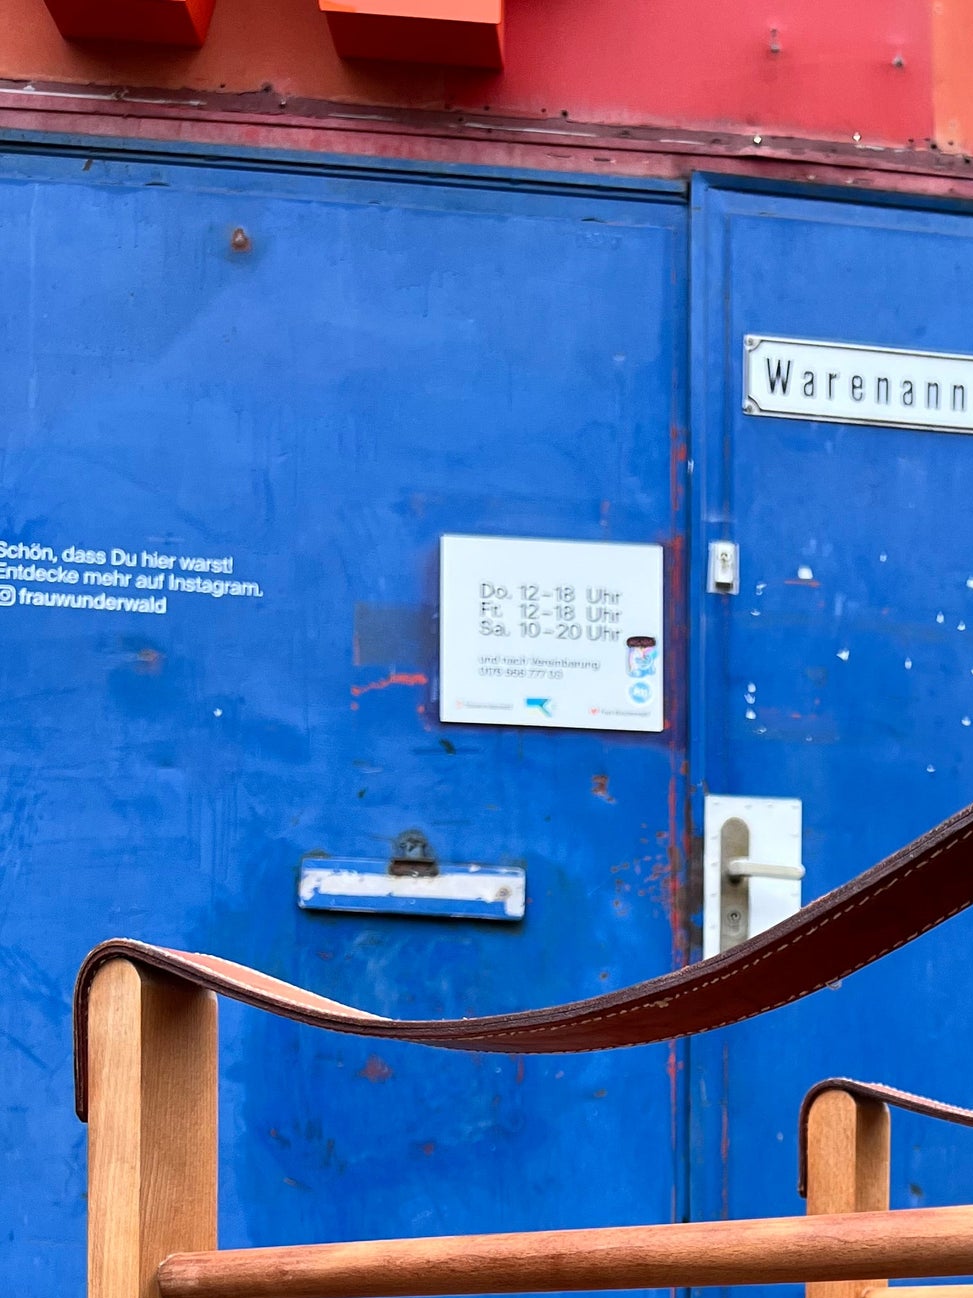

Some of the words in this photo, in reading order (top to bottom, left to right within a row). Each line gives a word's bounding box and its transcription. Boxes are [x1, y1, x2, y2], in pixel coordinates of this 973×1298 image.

[0, 540, 58, 564] Schön,
[61, 545, 107, 565] dass
[110, 548, 137, 567] Du
[141, 550, 177, 569] hier
[179, 556, 234, 574] warst!
[0, 561, 80, 584] Entdecke
[83, 569, 132, 588] mehr
[135, 572, 165, 590] auf
[168, 573, 264, 598] Instagram.
[19, 587, 167, 614] frauwunderwald
[480, 583, 512, 599] Do.
[586, 587, 621, 605] Uhr
[586, 606, 621, 623] Uhr
[479, 620, 511, 637] Sa.
[586, 624, 621, 641] Uhr
